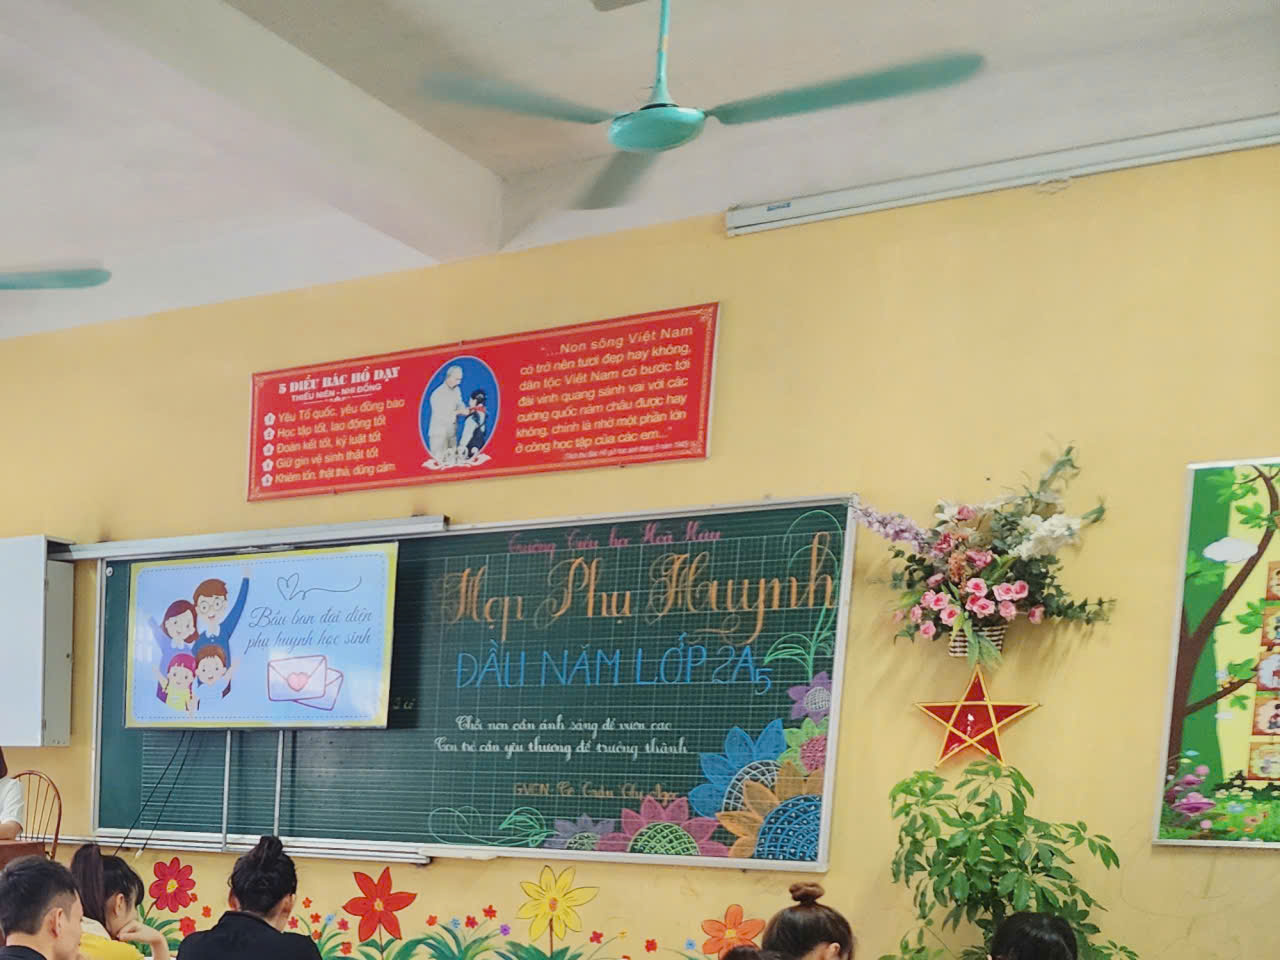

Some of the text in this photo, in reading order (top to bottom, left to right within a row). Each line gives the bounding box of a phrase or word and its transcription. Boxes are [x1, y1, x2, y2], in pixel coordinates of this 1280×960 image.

[590, 338, 624, 350] sông
[628, 331, 656, 344] Việt
[660, 327, 693, 339] Nam
[627, 349, 649, 362] hay
[278, 383, 287, 394] 5
[322, 373, 349, 387] BÁC
[351, 366, 371, 384] HỒ
[373, 366, 401, 382] DẠY
[564, 373, 587, 386] Việt
[590, 369, 619, 382] Nam
[561, 388, 596, 402] quang
[628, 381, 646, 393] vai
[666, 393, 688, 406] hay
[534, 556, 633, 630] Phụ
[644, 530, 836, 646] Huynh
[248, 605, 372, 628] Bầu ban đại diện
[244, 626, 372, 655] phụ huynh học sinh
[451, 639, 526, 688] ĐẦU
[540, 644, 621, 687] NĂM
[635, 632, 708, 685] LỚP
[487, 721, 509, 731] non
[539, 713, 565, 731] ánh
[645, 736, 688, 753] thành
